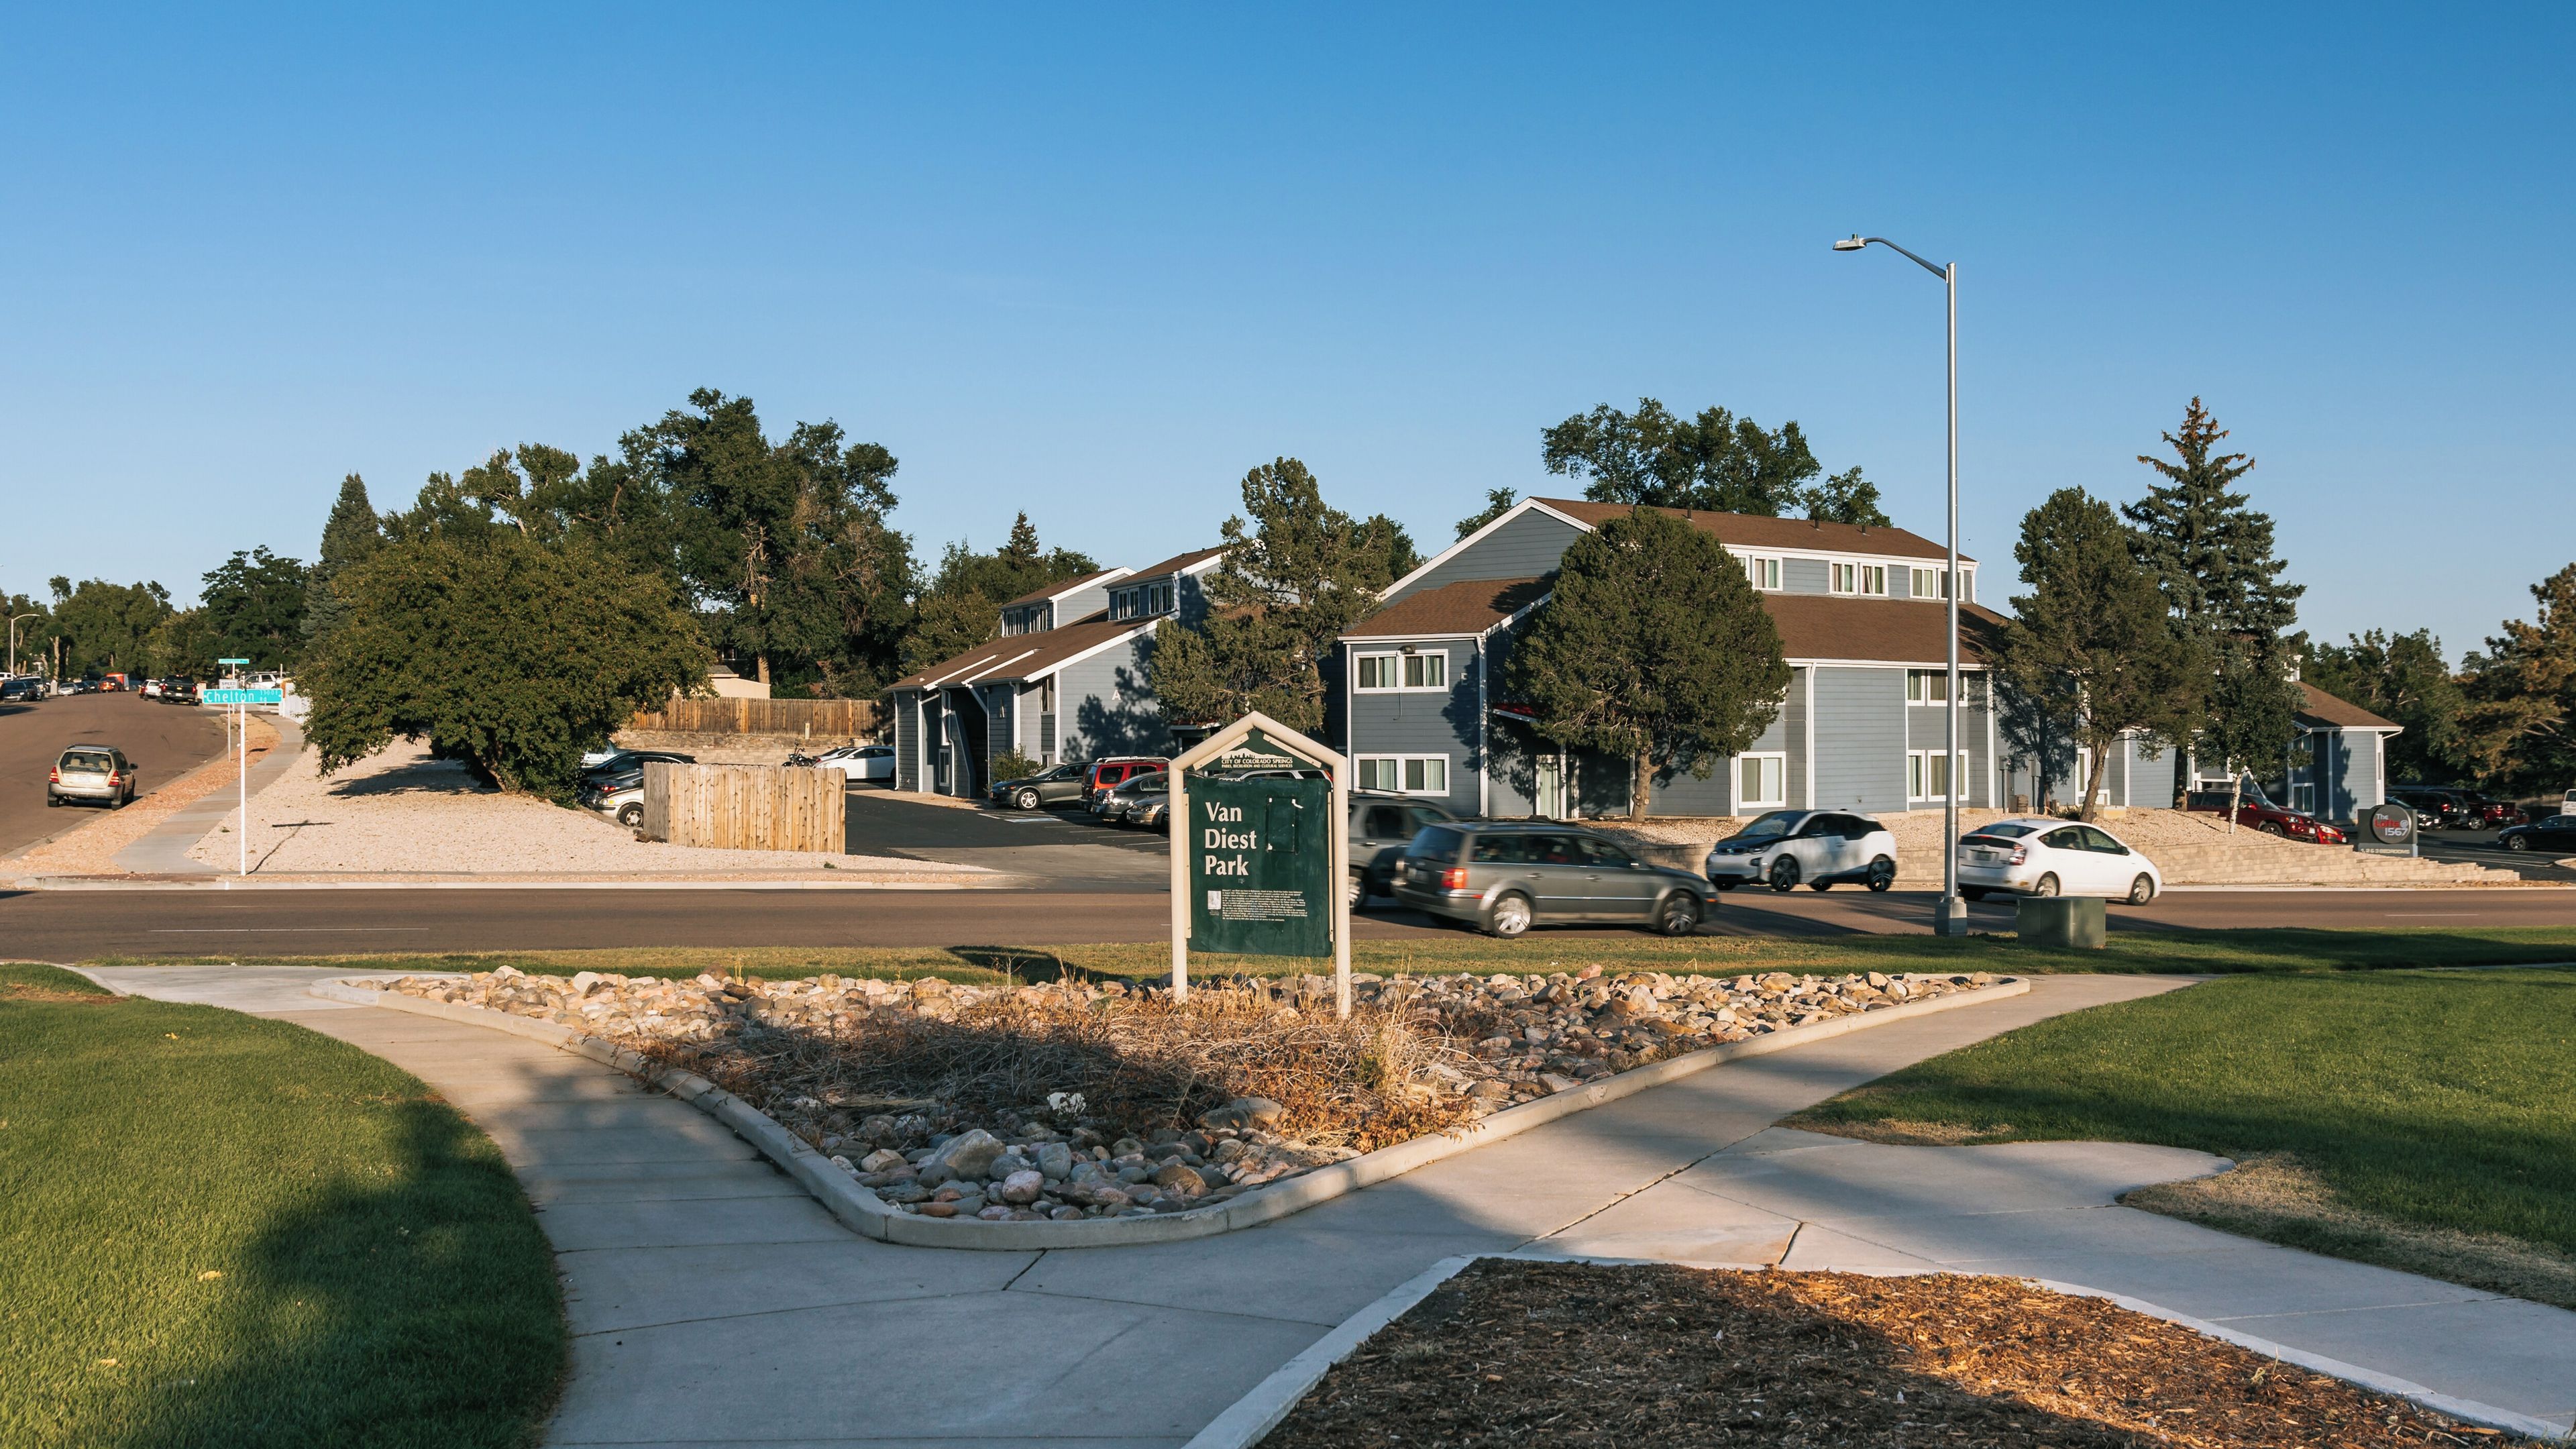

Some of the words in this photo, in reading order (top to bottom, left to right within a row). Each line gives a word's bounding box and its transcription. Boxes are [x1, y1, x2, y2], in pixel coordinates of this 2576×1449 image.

[207, 691, 254, 702] Chelton
[1112, 689, 1121, 700] A
[1205, 802, 1242, 822] Van
[1205, 827, 1257, 849] Diest
[2385, 827, 2408, 836] 1567
[1205, 854, 1249, 876] Park
